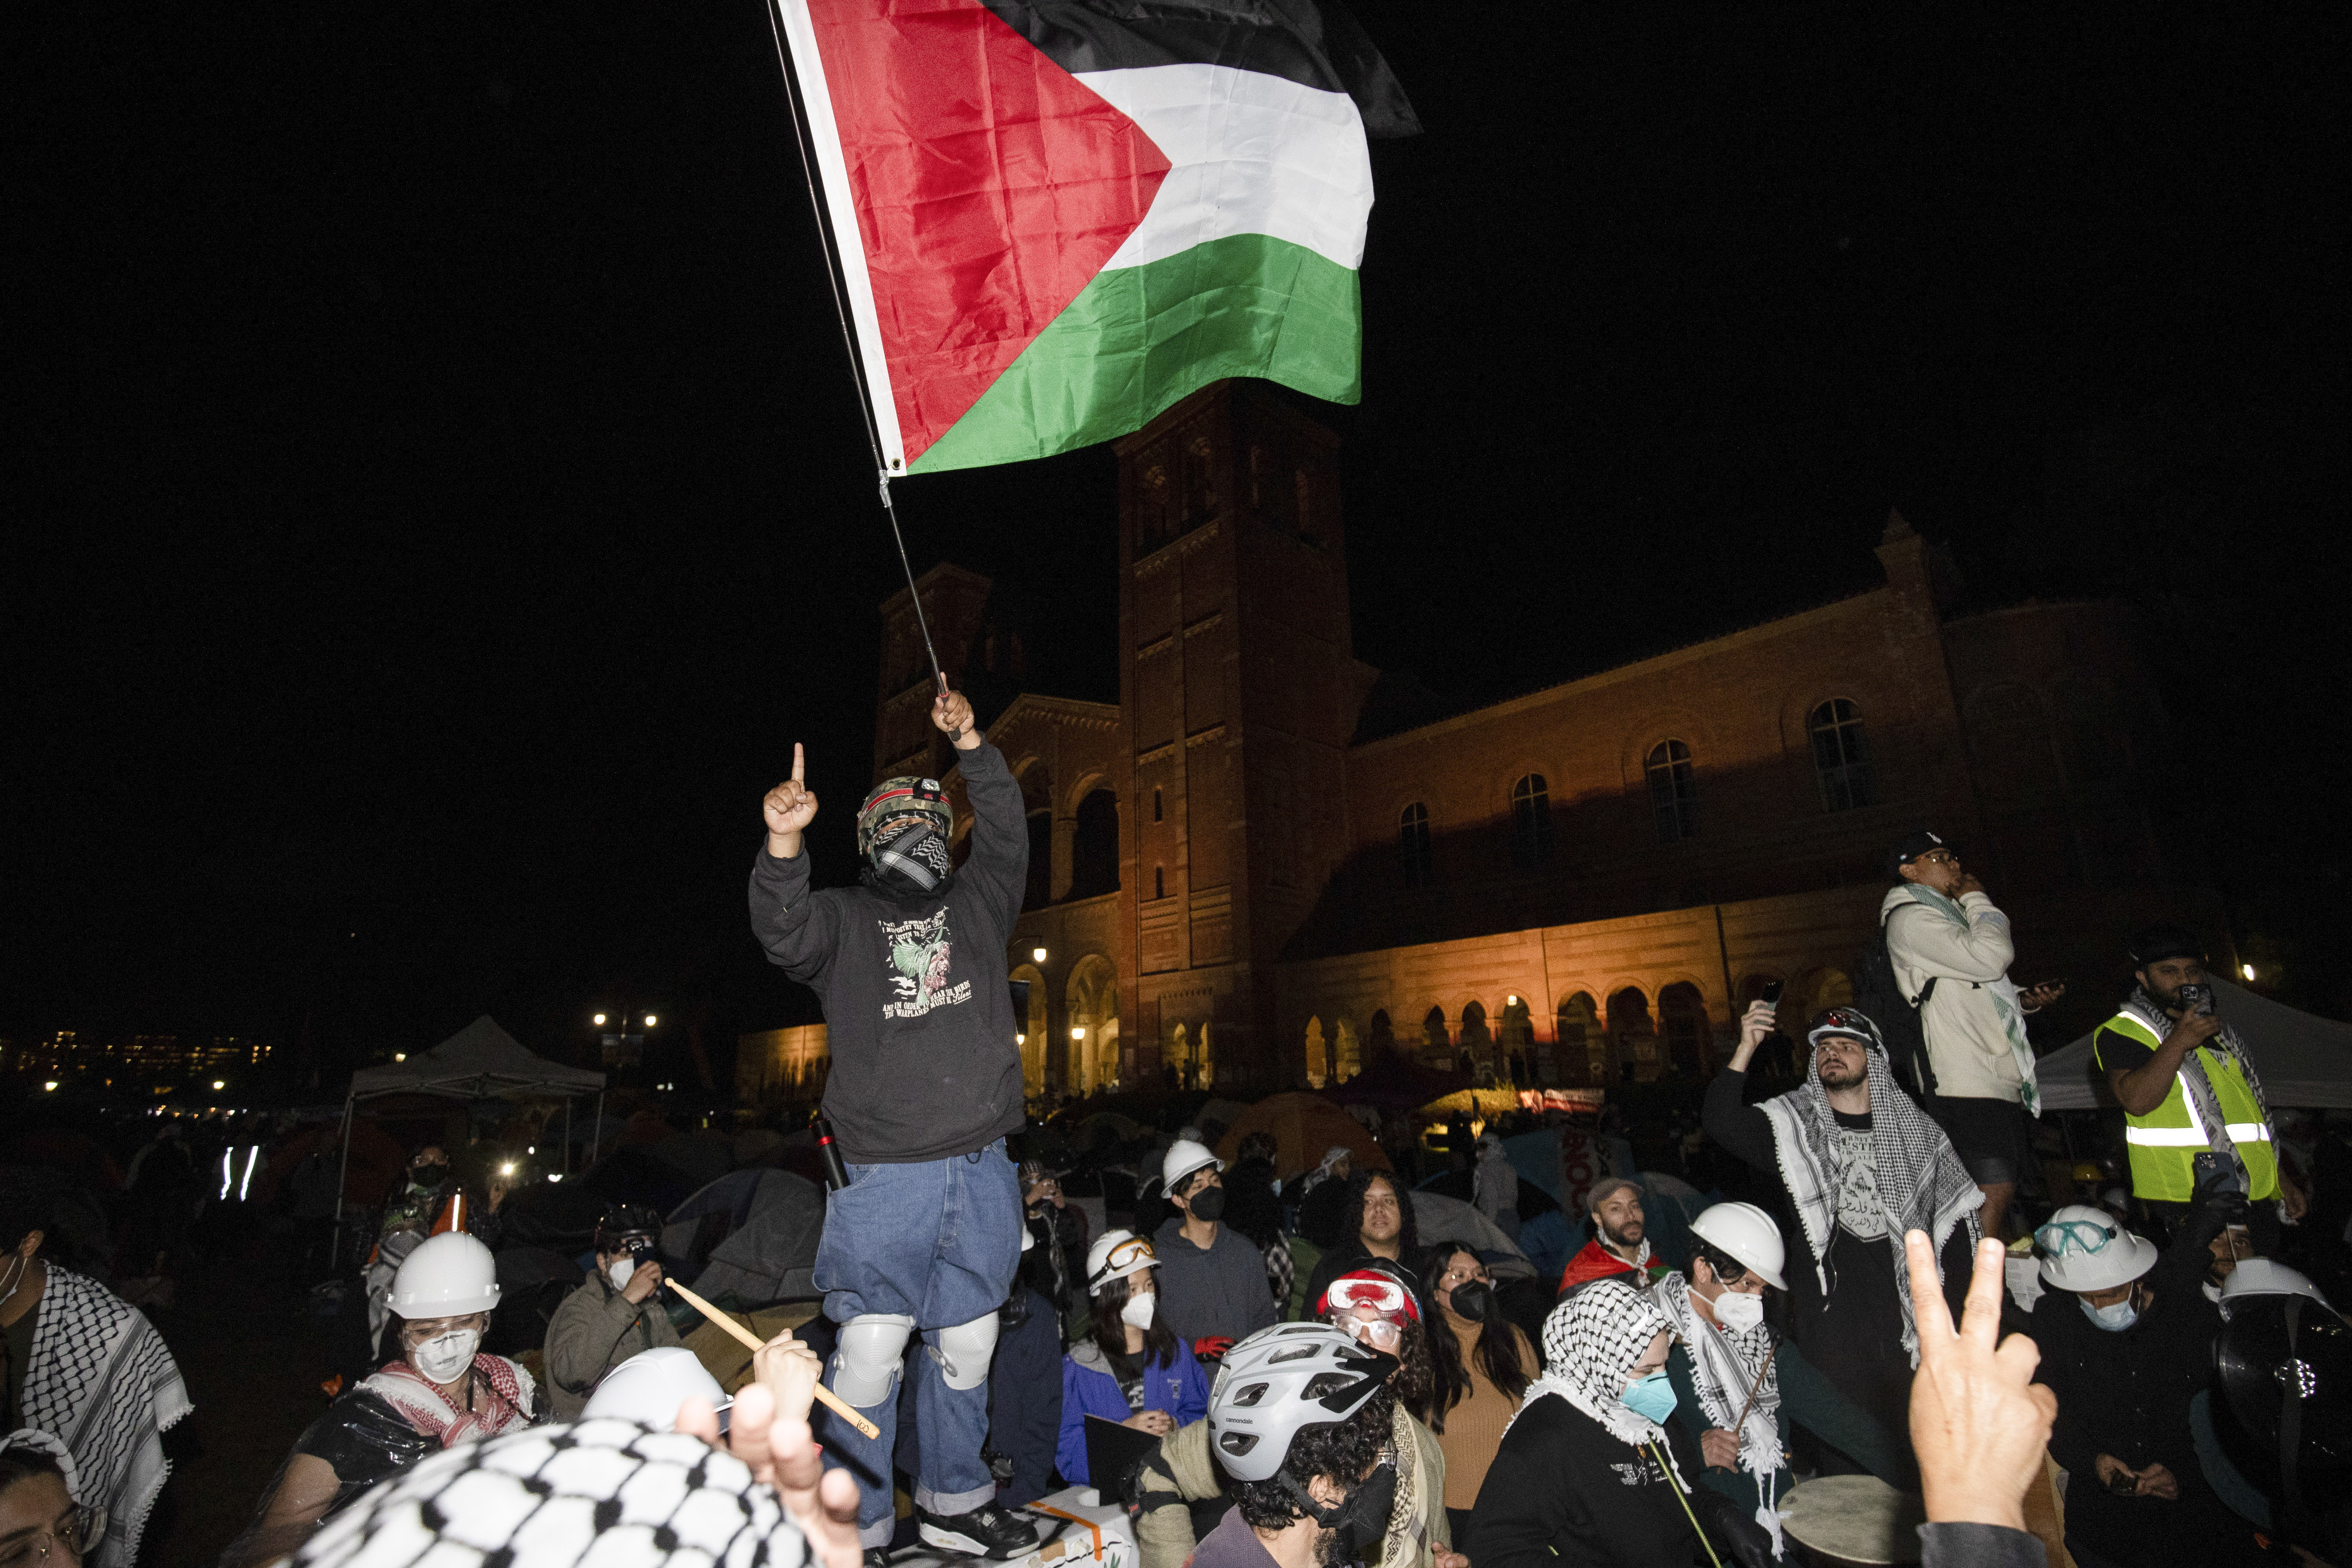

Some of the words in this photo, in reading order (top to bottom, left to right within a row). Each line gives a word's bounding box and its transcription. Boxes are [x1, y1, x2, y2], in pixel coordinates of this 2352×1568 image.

[930, 989, 946, 1002] HEAR
[953, 980, 971, 994] BIRDS
[885, 1010, 894, 1019] THE
[896, 1006, 929, 1017] WARPLANES
[930, 997, 946, 1009] MUST
